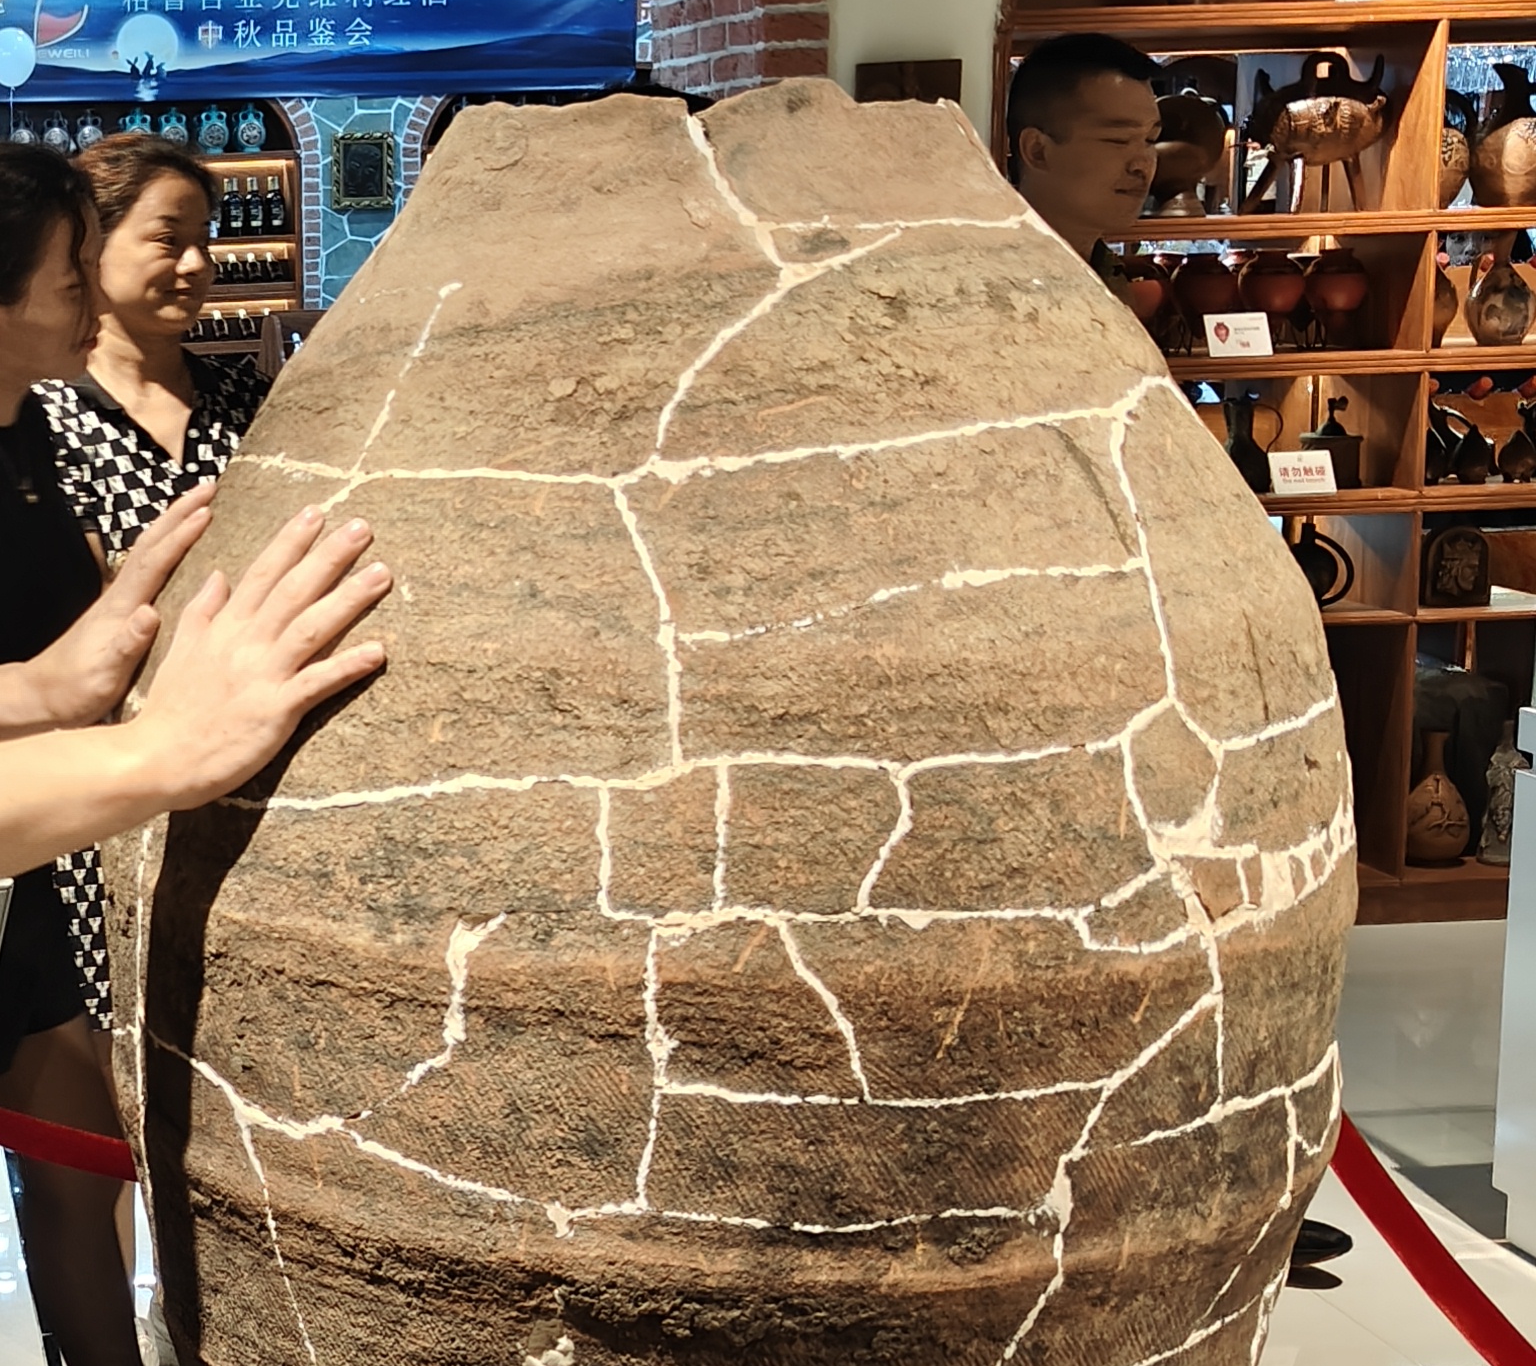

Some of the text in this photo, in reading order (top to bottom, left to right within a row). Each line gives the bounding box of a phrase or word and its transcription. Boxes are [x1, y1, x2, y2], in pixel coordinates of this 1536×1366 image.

[196, 16, 376, 50] 中秋品鉴会
[36, 47, 91, 59] EWEILI
